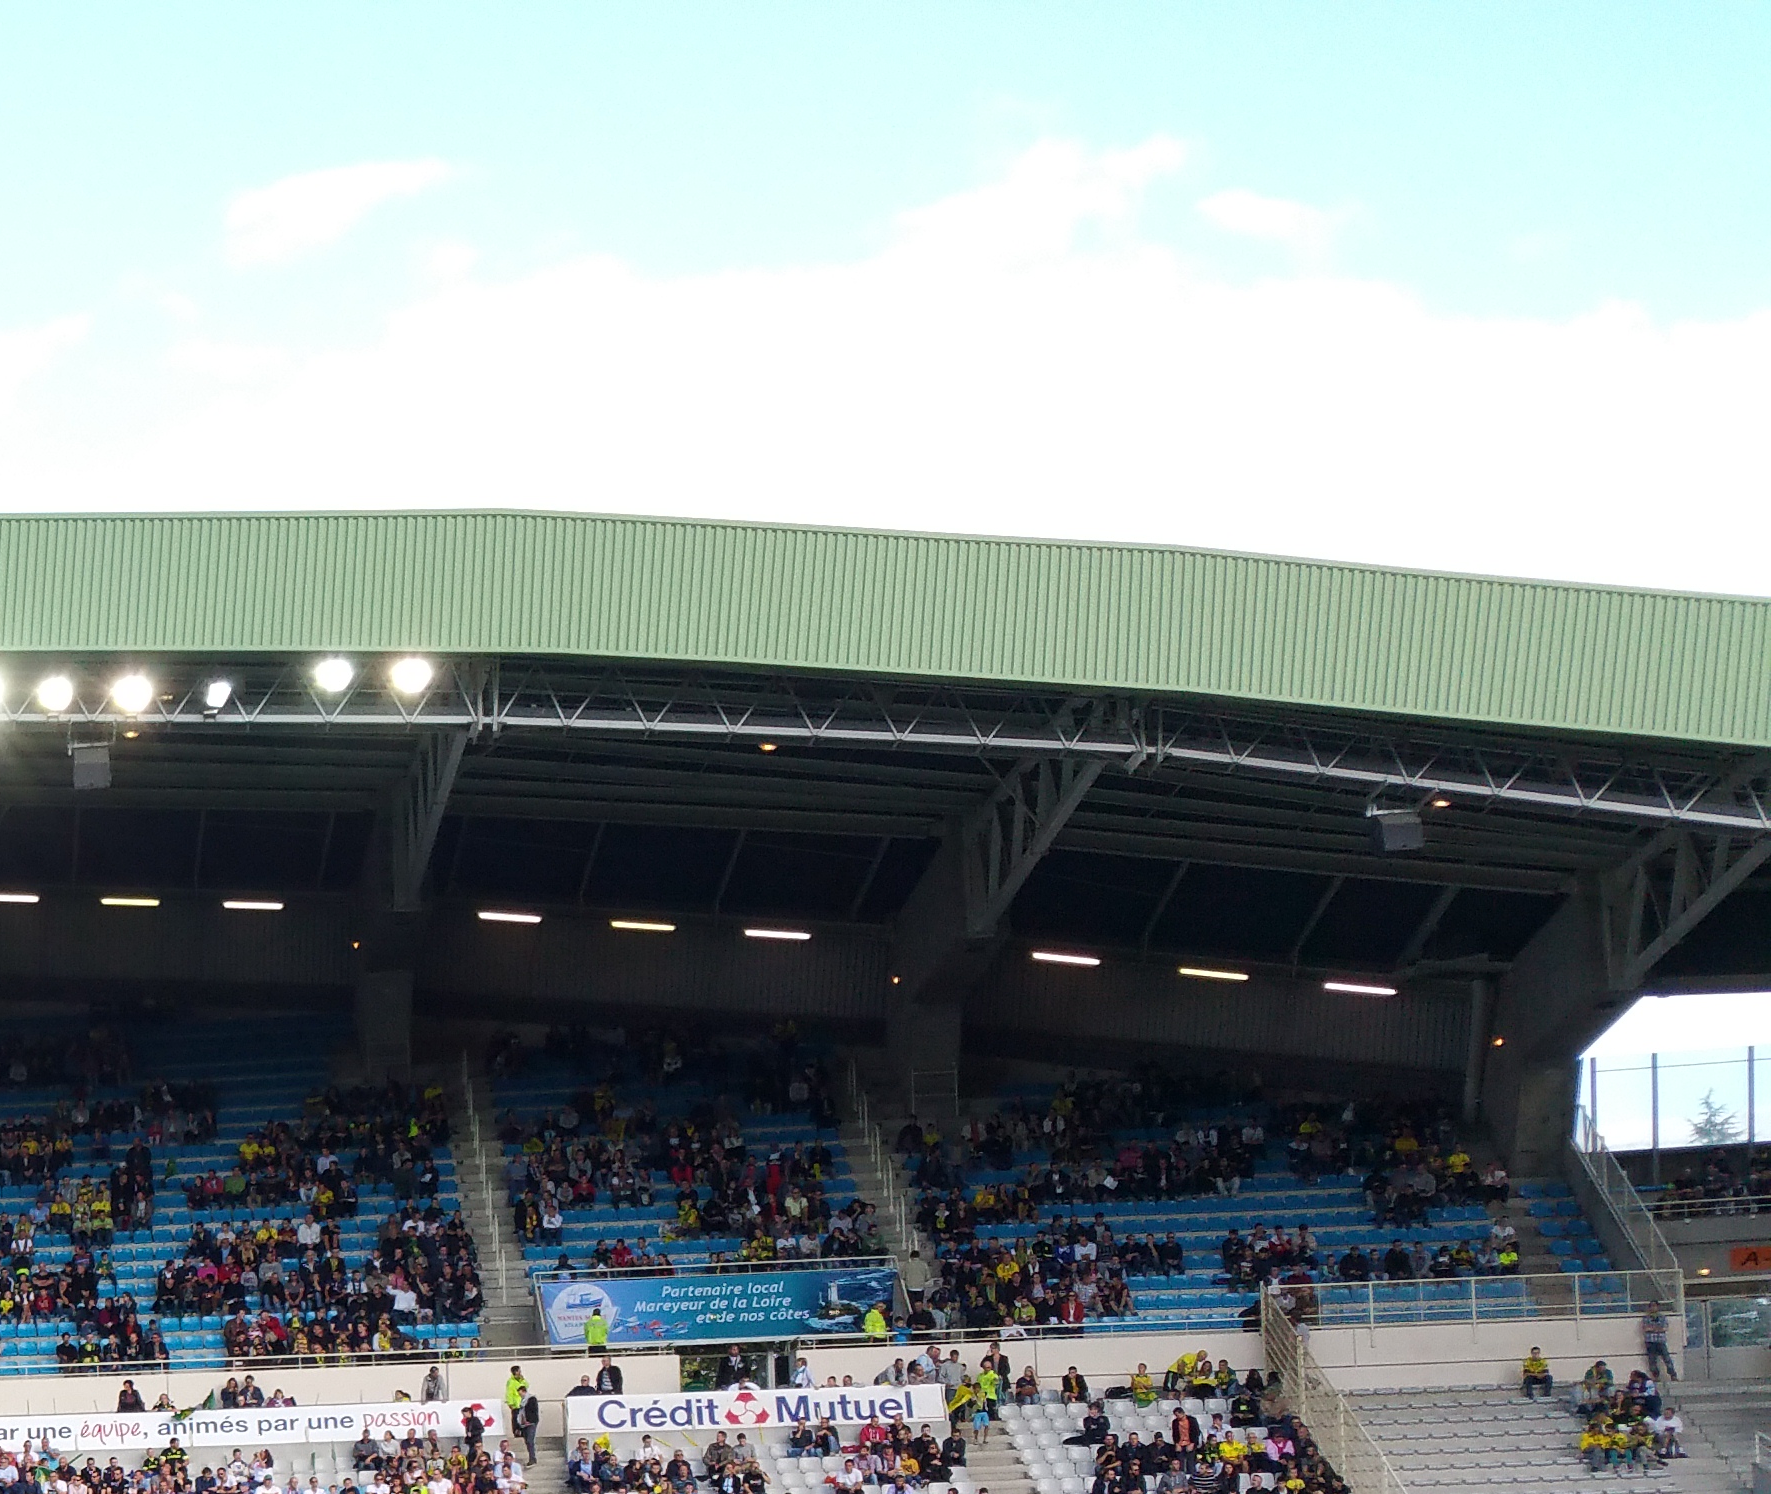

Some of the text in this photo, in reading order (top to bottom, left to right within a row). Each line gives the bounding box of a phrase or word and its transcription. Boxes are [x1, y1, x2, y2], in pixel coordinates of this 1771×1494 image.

[661, 1281, 784, 1298] Partenaire local
[634, 1295, 792, 1314] Mareyeur de la Loire
[695, 1311, 710, 1324] et
[739, 1311, 765, 1322] nos
[769, 1308, 810, 1320] côtes
[597, 1391, 914, 1429] Crédit Mutuel
[28, 1426, 72, 1440] une
[80, 1420, 148, 1446] équipe,
[157, 1415, 248, 1436] animés
[258, 1417, 299, 1436] par
[308, 1414, 354, 1430] une
[363, 1410, 440, 1433] passion
